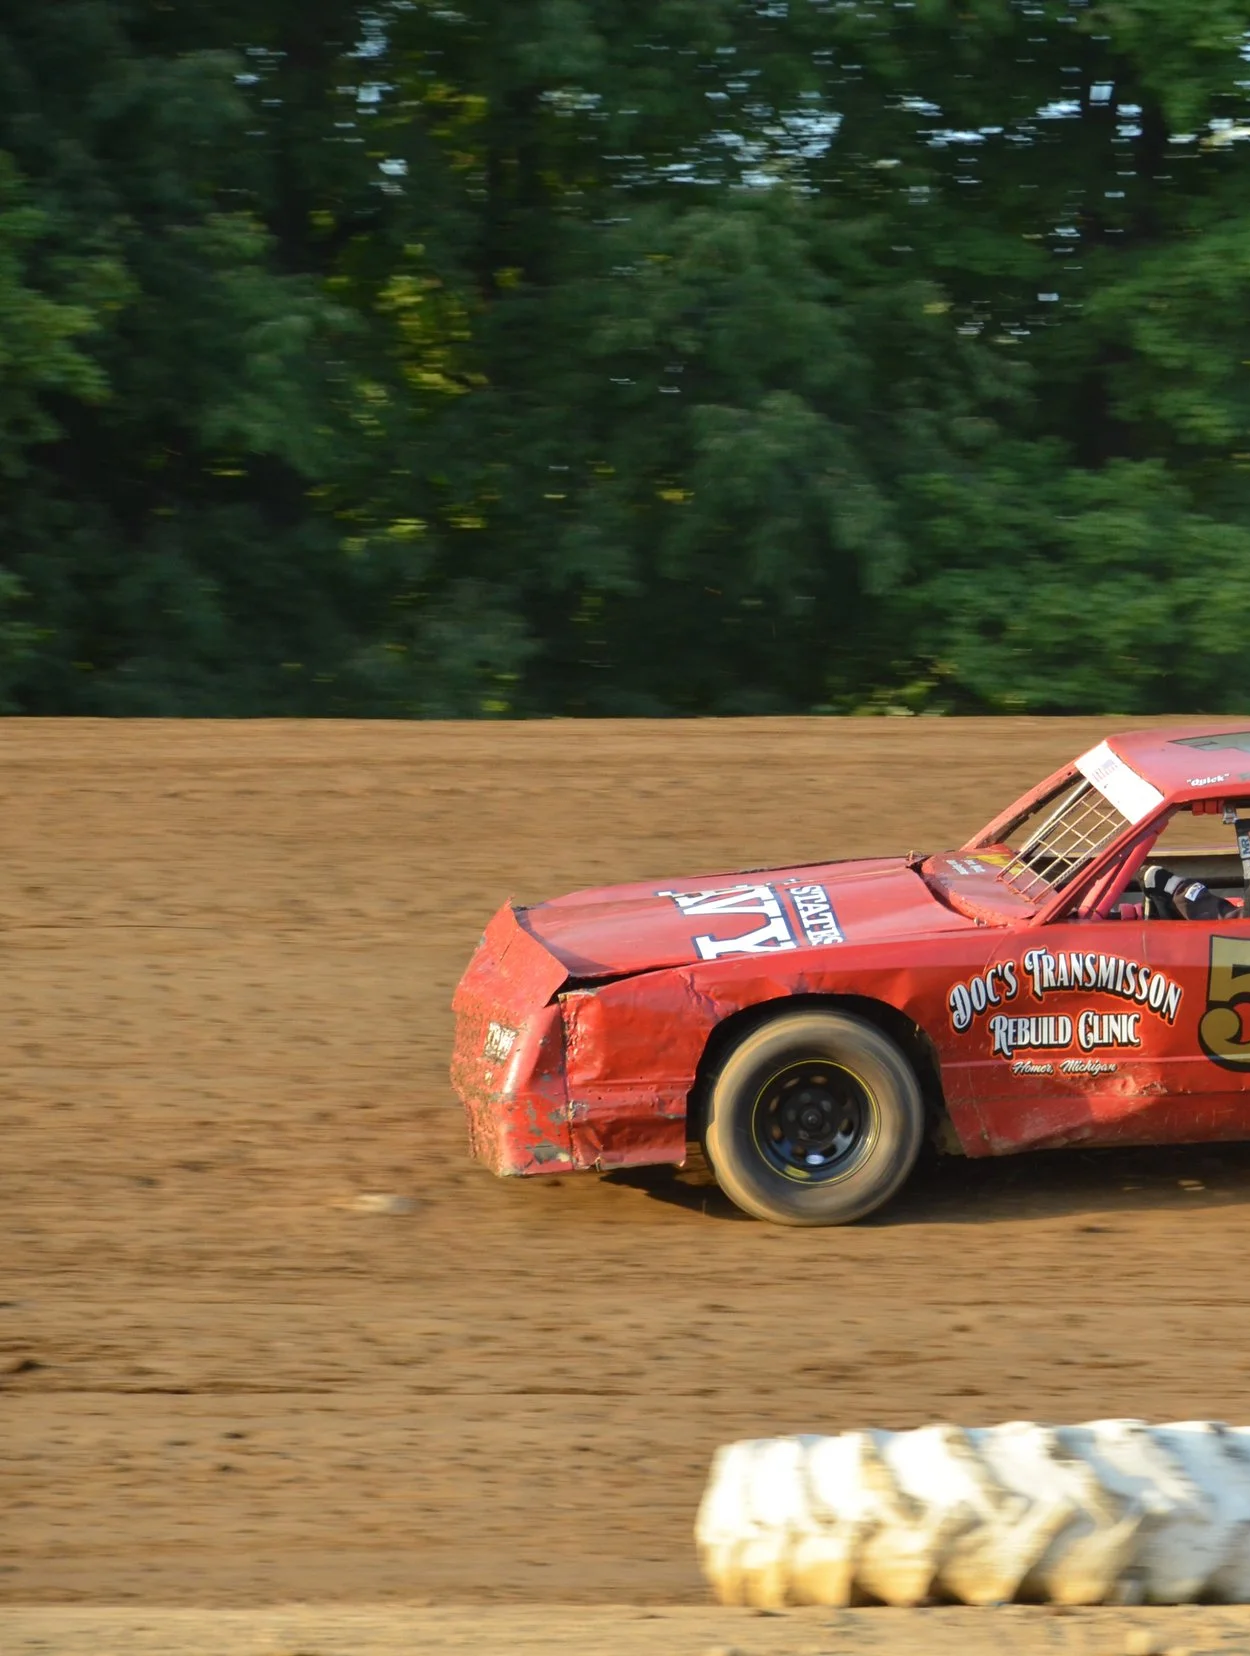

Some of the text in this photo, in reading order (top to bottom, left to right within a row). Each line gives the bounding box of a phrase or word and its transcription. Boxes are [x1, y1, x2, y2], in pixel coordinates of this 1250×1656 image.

[950, 961, 1018, 1033] DOC'S
[989, 1011, 1142, 1058] REBUILD CLINIC
[1011, 1059, 1118, 1078] Homer, Michigan
